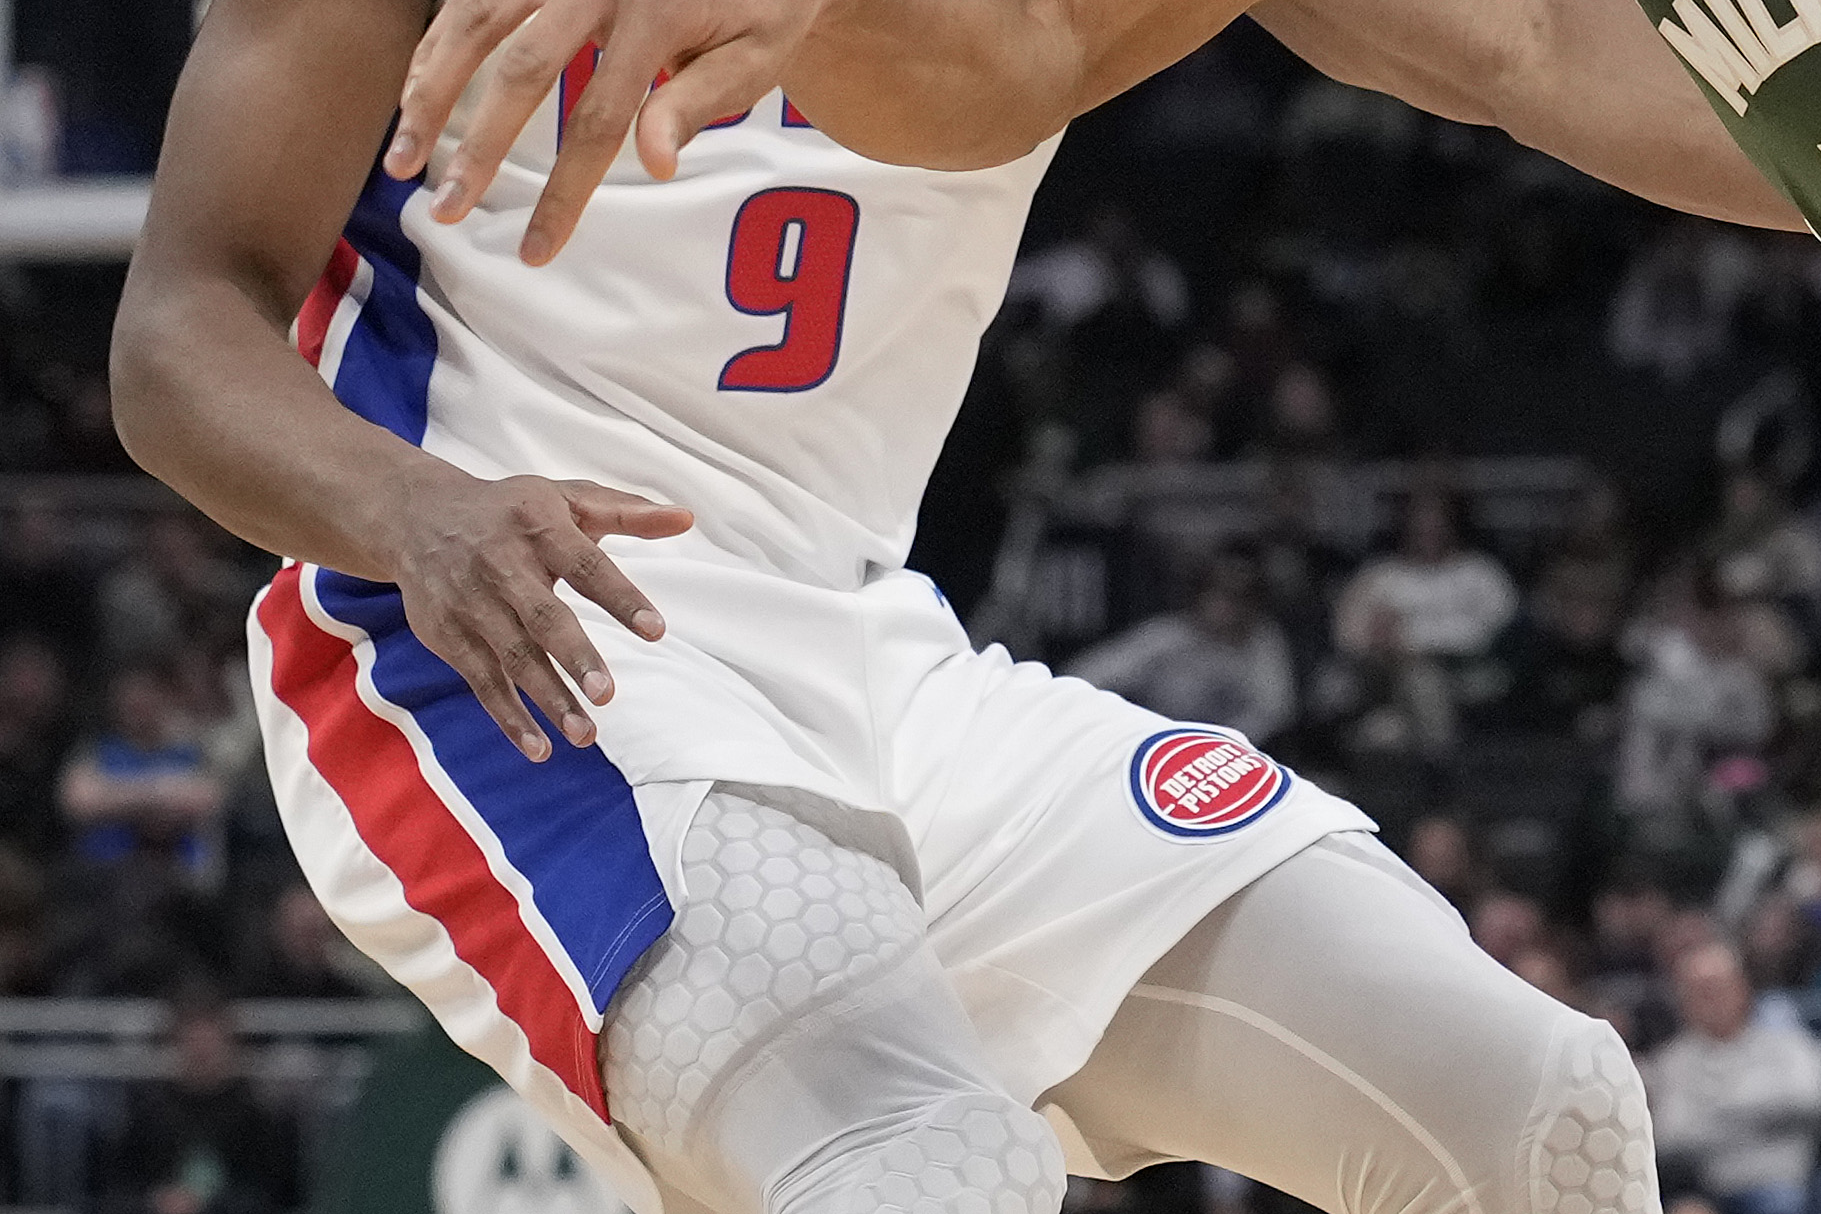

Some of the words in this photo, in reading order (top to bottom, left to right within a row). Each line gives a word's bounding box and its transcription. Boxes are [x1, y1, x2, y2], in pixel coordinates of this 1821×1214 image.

[716, 186, 861, 393] 9
[1160, 743, 1242, 799] DETROIT
[1177, 753, 1263, 814] PISTONS
